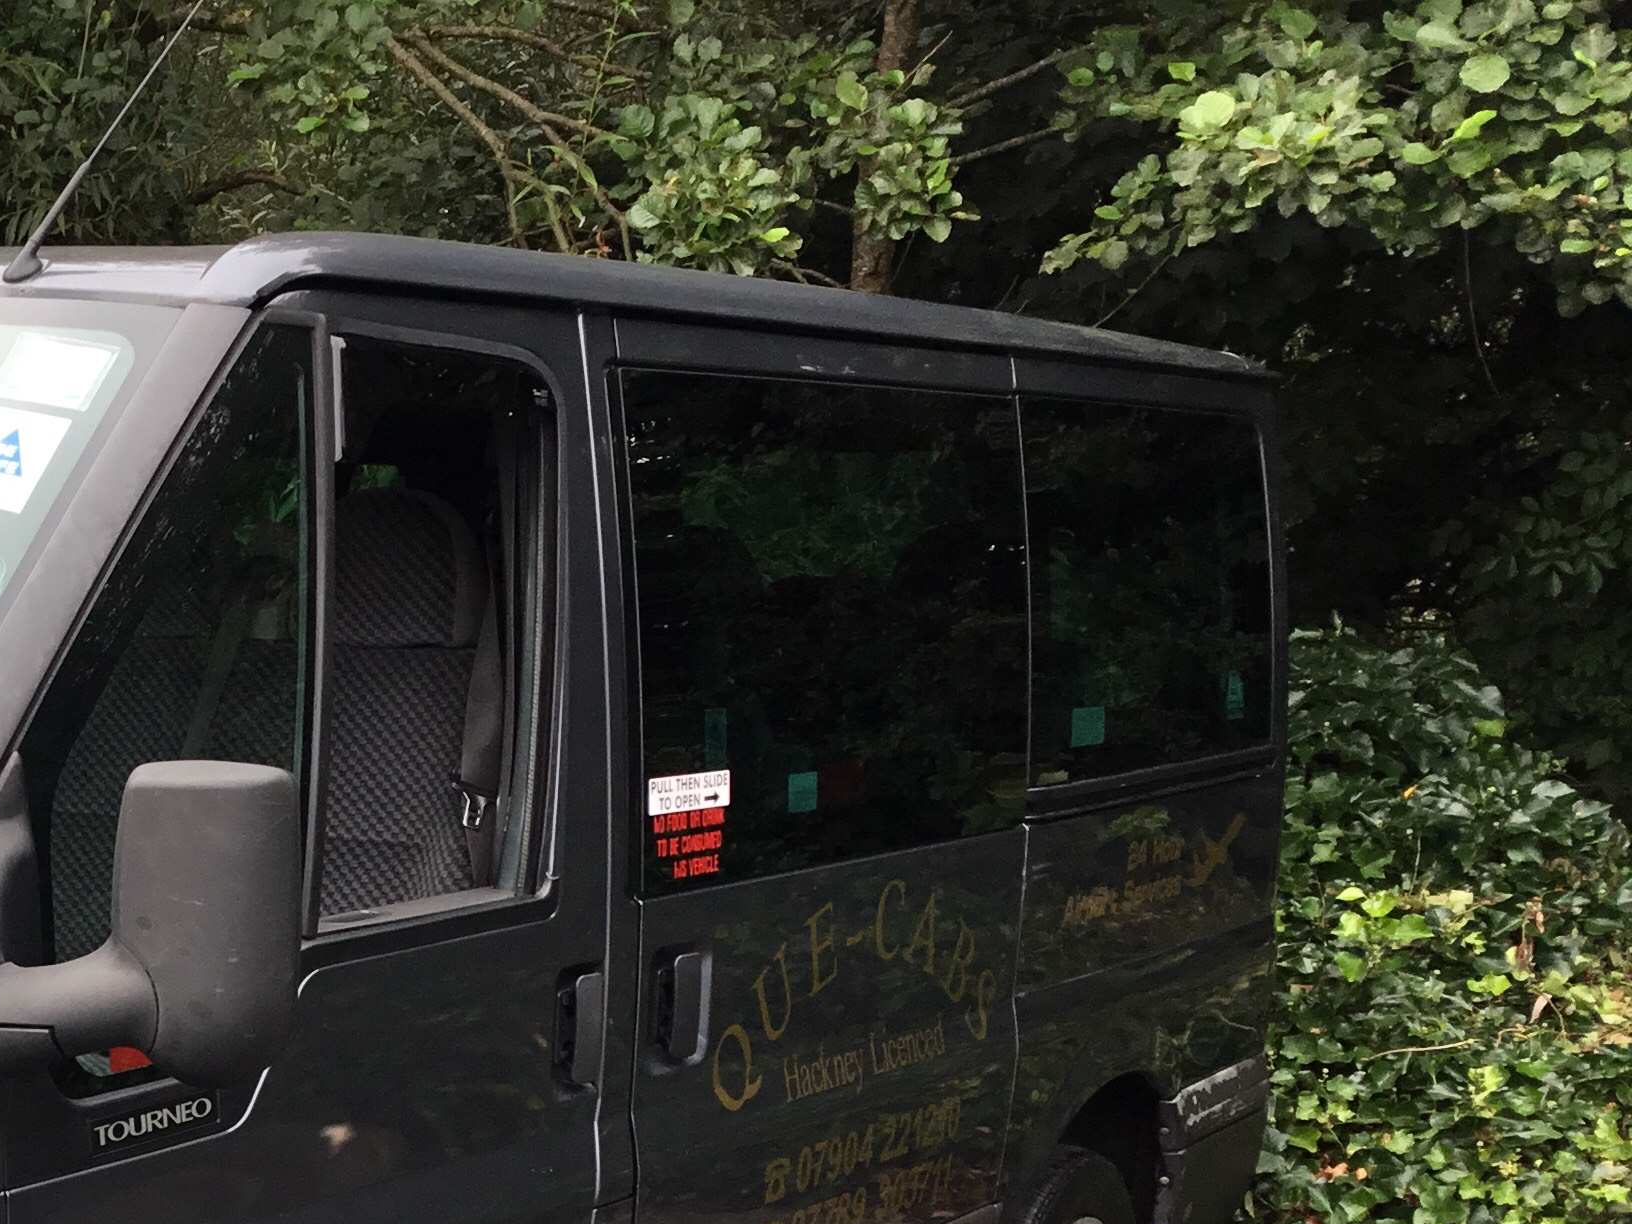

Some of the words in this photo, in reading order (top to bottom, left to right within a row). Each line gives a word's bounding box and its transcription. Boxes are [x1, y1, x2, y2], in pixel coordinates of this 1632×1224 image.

[651, 779, 673, 795] PULL
[676, 776, 701, 792] THEN
[703, 773, 728, 789] SLIDE
[659, 796, 672, 811] TO
[674, 793, 701, 809] OPEN
[667, 812, 687, 832] FOOD
[690, 809, 701, 828] OR
[702, 808, 725, 826] DRINK
[657, 838, 668, 857] TO
[670, 837, 679, 855] BE
[681, 831, 722, 853] CONSUMED
[689, 854, 719, 876] VEHICLE
[713, 878, 996, 1112] QUE-CABS
[784, 1045, 864, 1103] Hackney
[870, 1013, 946, 1076] Licenced
[94, 1097, 212, 1146] TOURNEO
